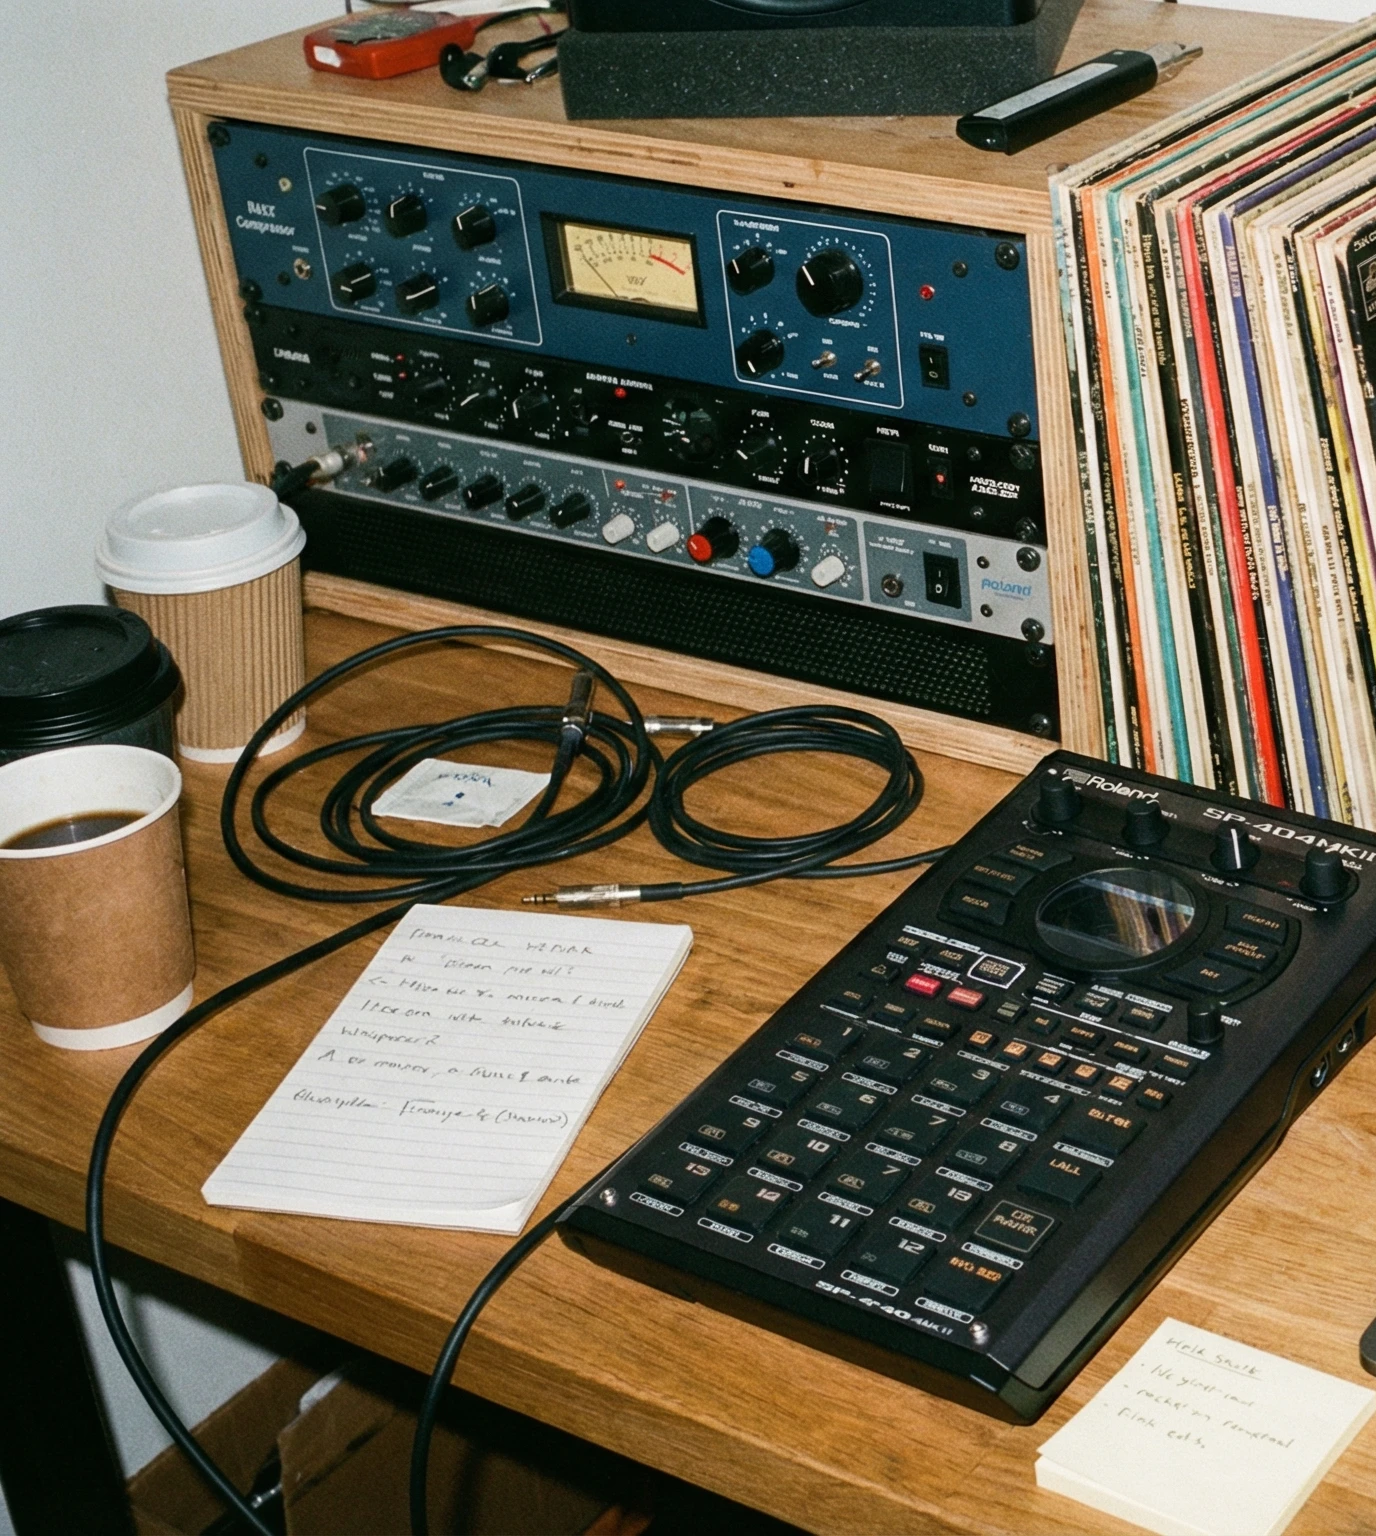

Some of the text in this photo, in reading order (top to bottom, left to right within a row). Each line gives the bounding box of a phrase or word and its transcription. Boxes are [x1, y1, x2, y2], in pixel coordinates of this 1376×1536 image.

[903, 1047, 922, 1059] 2
[971, 1069, 991, 1081] 3
[858, 1093, 877, 1105] 6
[928, 1114, 948, 1126] 7
[806, 1139, 830, 1153] 10
[829, 1213, 851, 1228] 11
[897, 1238, 925, 1255] 12
